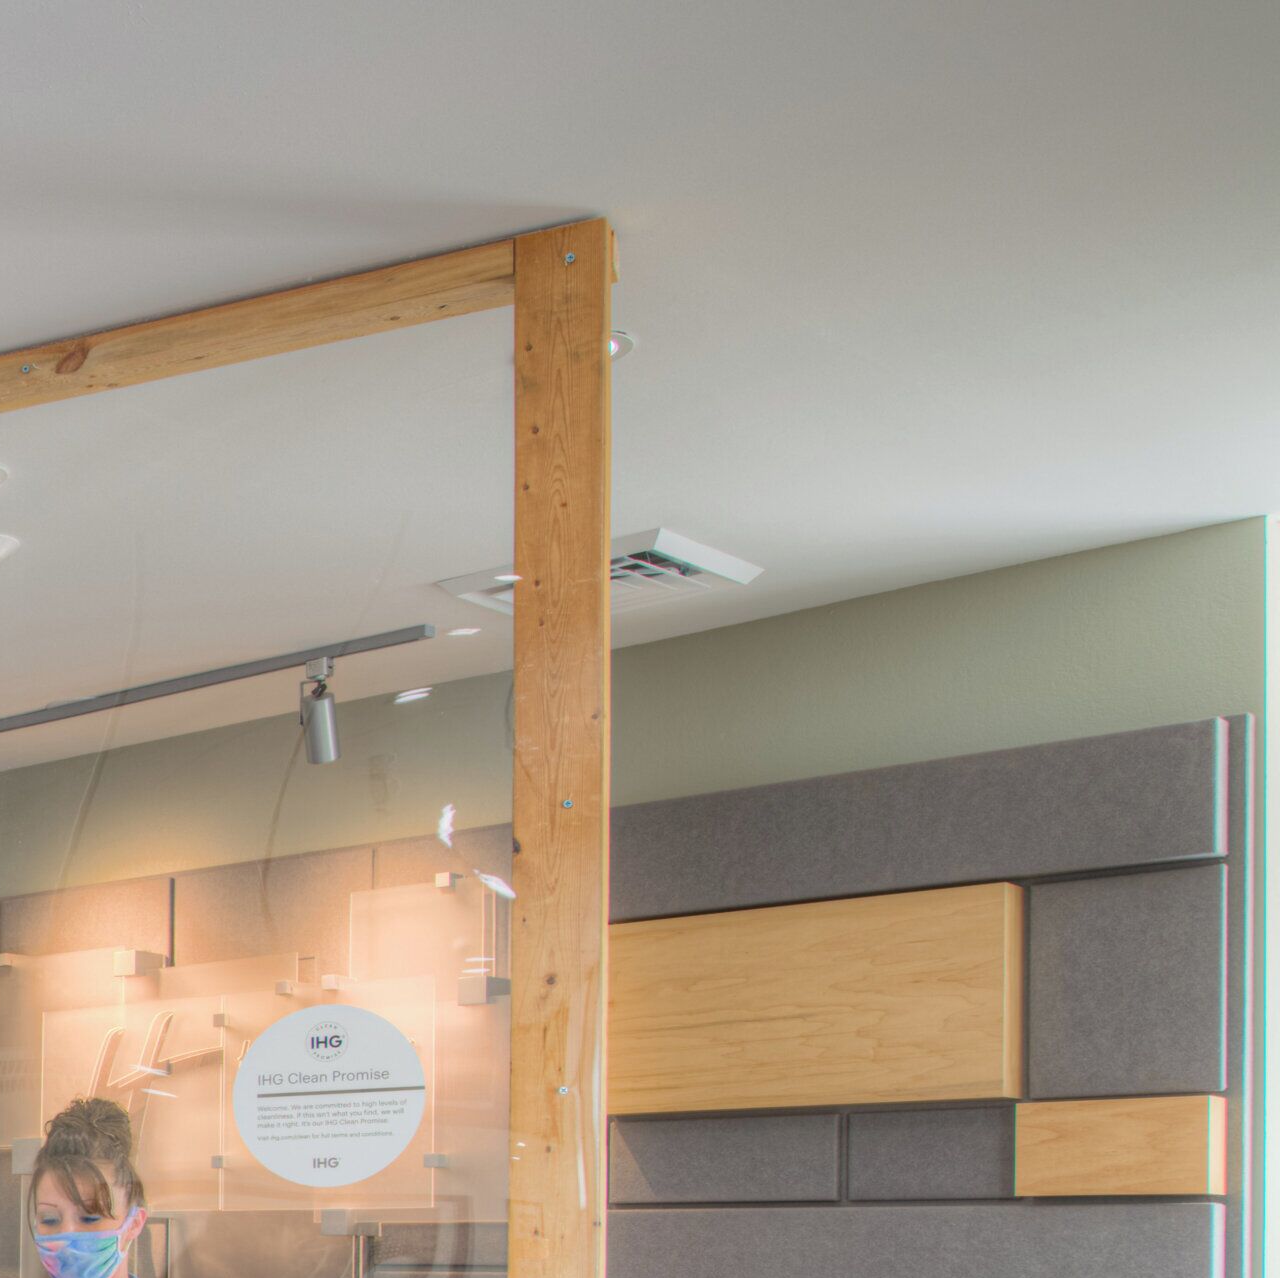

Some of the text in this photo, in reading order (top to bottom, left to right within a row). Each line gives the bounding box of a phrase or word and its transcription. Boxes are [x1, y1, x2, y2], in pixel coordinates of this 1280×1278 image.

[310, 1034, 343, 1050] IHG
[257, 1068, 390, 1086] IHG Clean Promise
[315, 1102, 352, 1110] committed
[362, 1100, 377, 1109] high
[379, 1098, 398, 1106] levels
[350, 1110, 362, 1118] you
[339, 1118, 359, 1126] Clean
[312, 1156, 340, 1169] IHG
